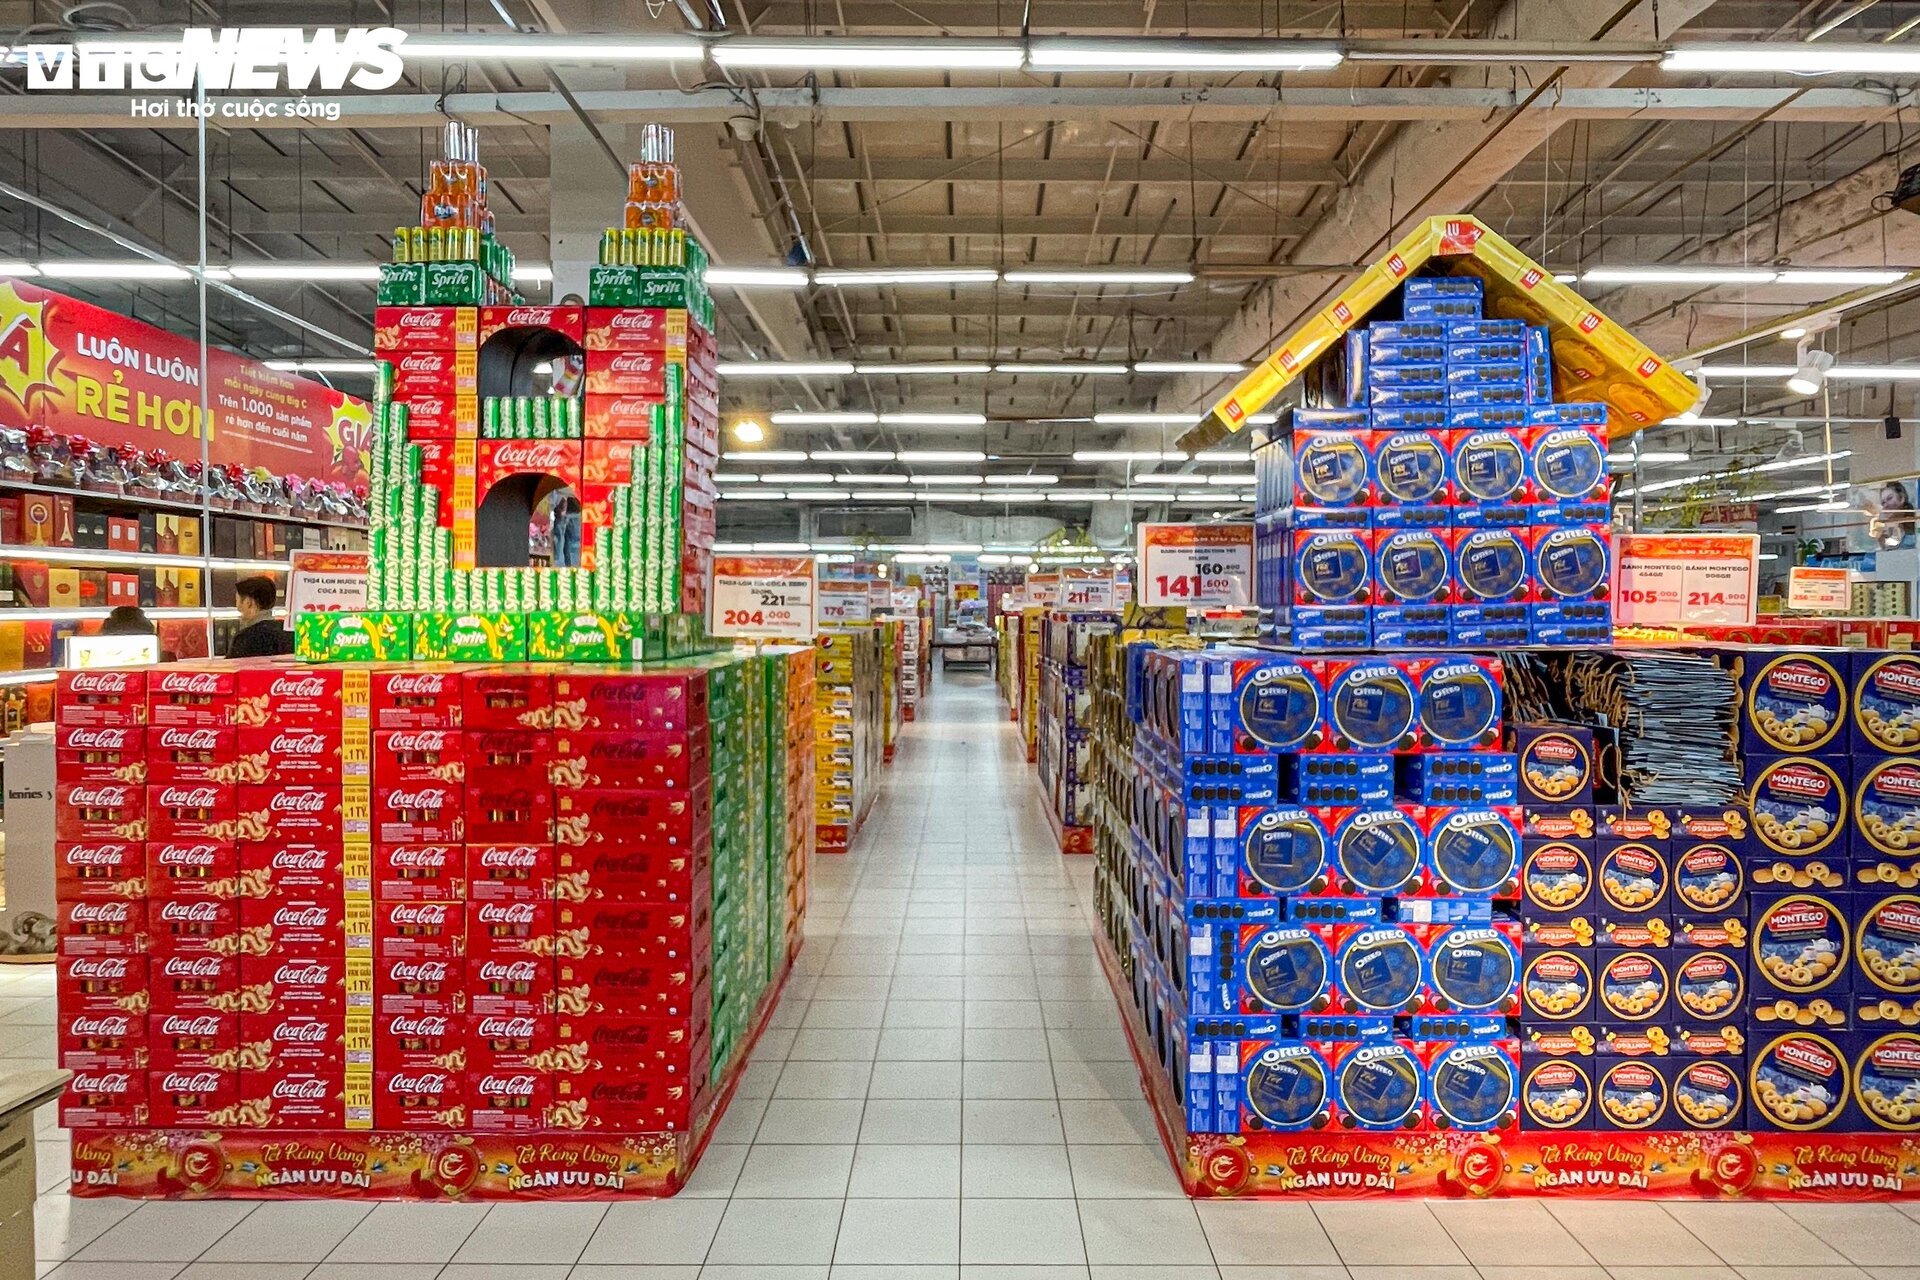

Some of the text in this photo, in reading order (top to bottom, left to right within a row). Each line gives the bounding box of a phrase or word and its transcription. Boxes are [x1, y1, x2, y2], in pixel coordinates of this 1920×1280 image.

[432, 273, 469, 288] Sprite
[593, 270, 633, 287] Sprite
[644, 281, 681, 296] Sprite
[77, 332, 199, 387] LUÔN LUÔN
[76, 370, 130, 424] RẺ
[137, 390, 215, 442] HƠN
[218, 394, 238, 408] Trên
[241, 397, 274, 418] 1.000
[1390, 433, 1431, 448] OREO
[1468, 431, 1510, 447] OREO
[1545, 429, 1588, 445] OREO
[1393, 531, 1433, 546] OREO
[1471, 530, 1512, 545] OREO
[1550, 528, 1592, 544] OREO
[1195, 563, 1223, 574] 160
[1155, 575, 1202, 597] 141
[761, 595, 785, 606] 221
[1621, 590, 1658, 603] 105
[1688, 592, 1725, 606] 214
[724, 609, 764, 625] 204
[333, 632, 370, 648] Sprite
[451, 631, 488, 647] Sprite
[569, 630, 606, 647] Sprite
[1254, 665, 1302, 683] OREO
[1350, 666, 1398, 684] OREO
[1433, 664, 1480, 681] OREO
[1772, 671, 1826, 687] MONTEGO
[1538, 745, 1574, 755] MONTEGO
[1772, 774, 1826, 789] MONTEGO
[1261, 810, 1309, 827] OREO
[1354, 810, 1403, 828] OREO
[1450, 811, 1500, 830] OREO
[1538, 854, 1575, 863] MONTEGO
[1771, 908, 1824, 924] MONTEGO
[1261, 929, 1310, 947] OREO
[1356, 929, 1405, 946] OREO
[1449, 929, 1498, 946] OREO
[1538, 963, 1576, 973] MONTEGO
[1613, 963, 1649, 976] MONTEGO
[1261, 1046, 1311, 1063] OREO
[1355, 1046, 1405, 1063] OREO
[1449, 1045, 1498, 1063] OREO
[1779, 1043, 1832, 1069] MONTEGO
[1535, 1072, 1574, 1082] MONTEGO
[1615, 1073, 1652, 1083] MONTEGO
[86, 1166, 118, 1185] ĐÃI
[256, 1168, 305, 1188] NGÀN
[340, 1167, 371, 1188] ĐÃI
[508, 1170, 559, 1190] NGÀN
[594, 1171, 624, 1190] ĐÃI
[1280, 1170, 1330, 1190] NGÀN
[1365, 1172, 1395, 1190] ĐÃI
[1534, 1170, 1583, 1189] NGÀN
[1617, 1172, 1648, 1189] ĐÃI
[1788, 1171, 1837, 1190] NGÀN
[1872, 1172, 1903, 1190] ĐÃI
